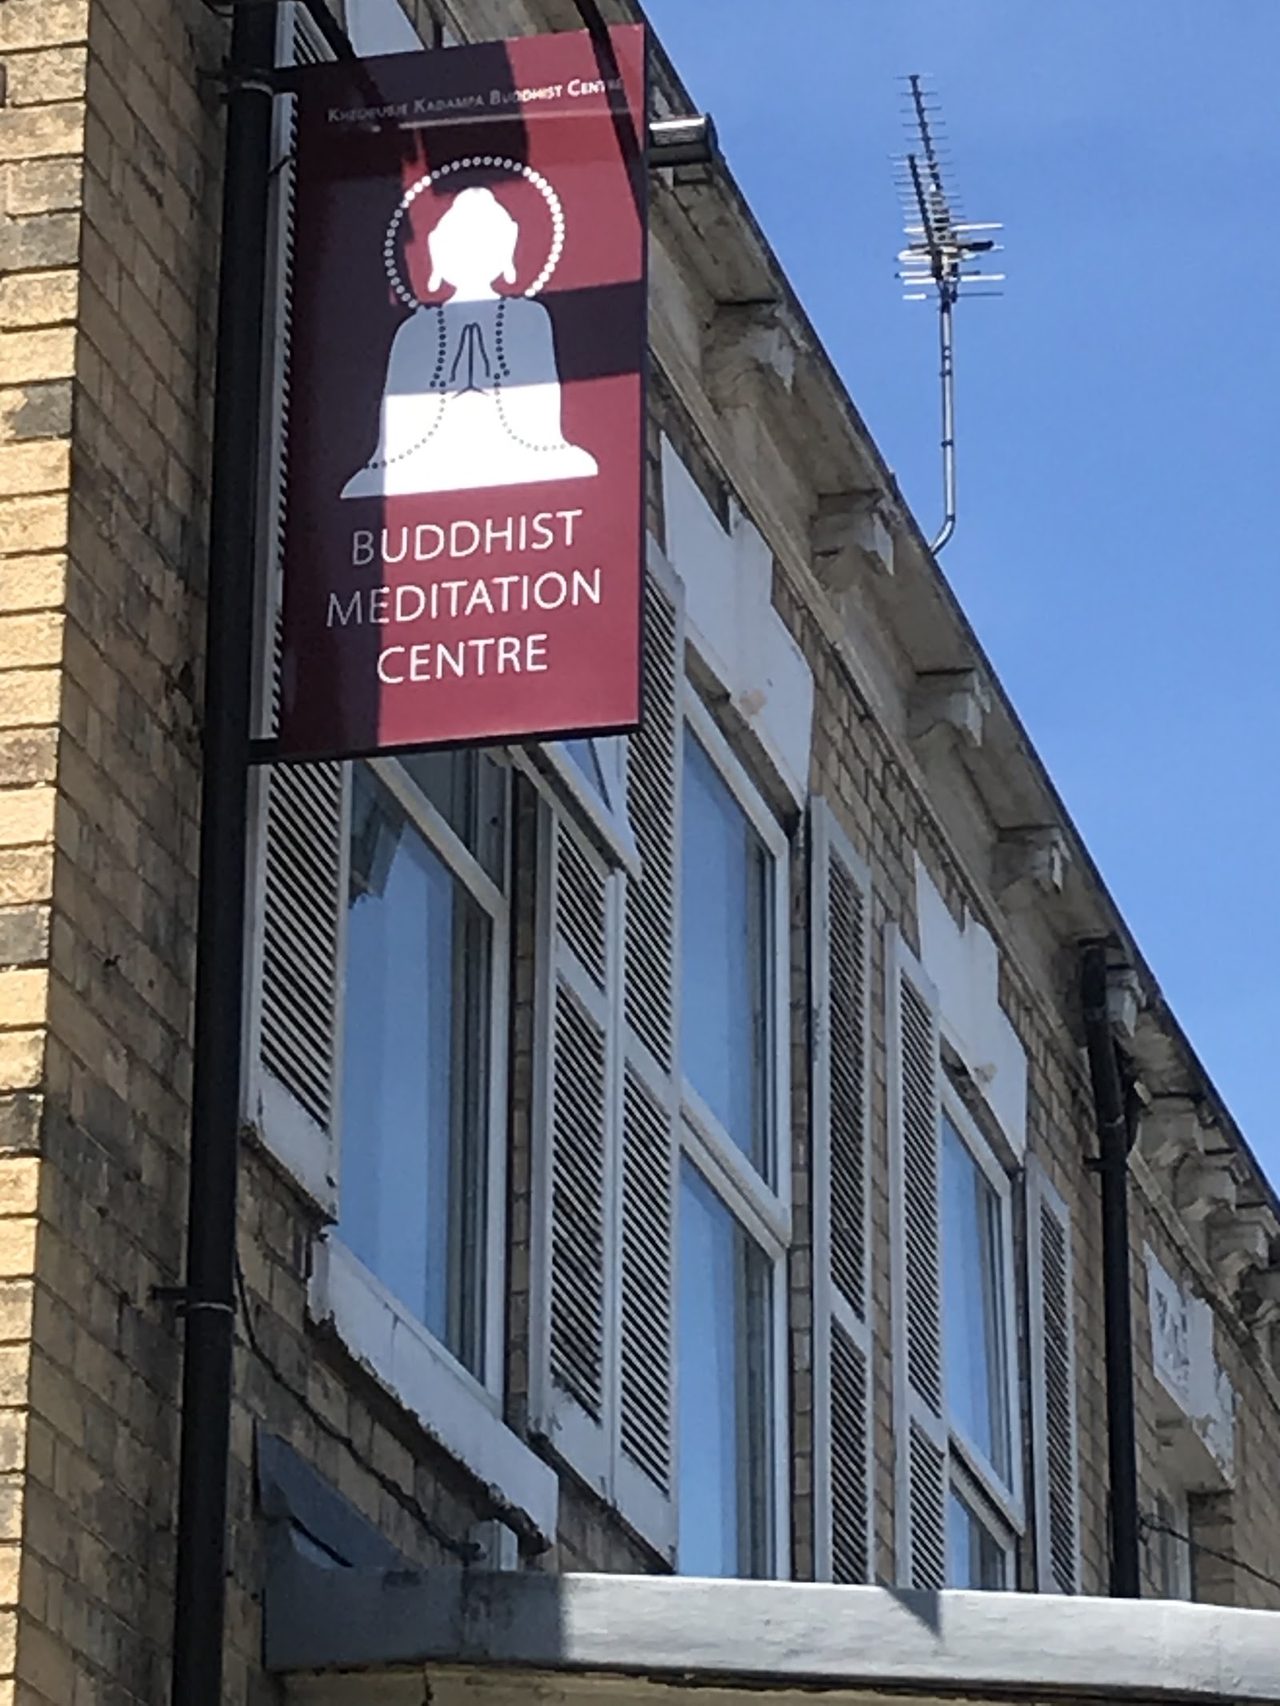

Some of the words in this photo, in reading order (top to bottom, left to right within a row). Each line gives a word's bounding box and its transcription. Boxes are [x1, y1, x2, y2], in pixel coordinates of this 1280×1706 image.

[352, 509, 583, 566] BUDDHIST
[326, 567, 601, 627] MEDITATION
[376, 633, 548, 684] CENTRE
